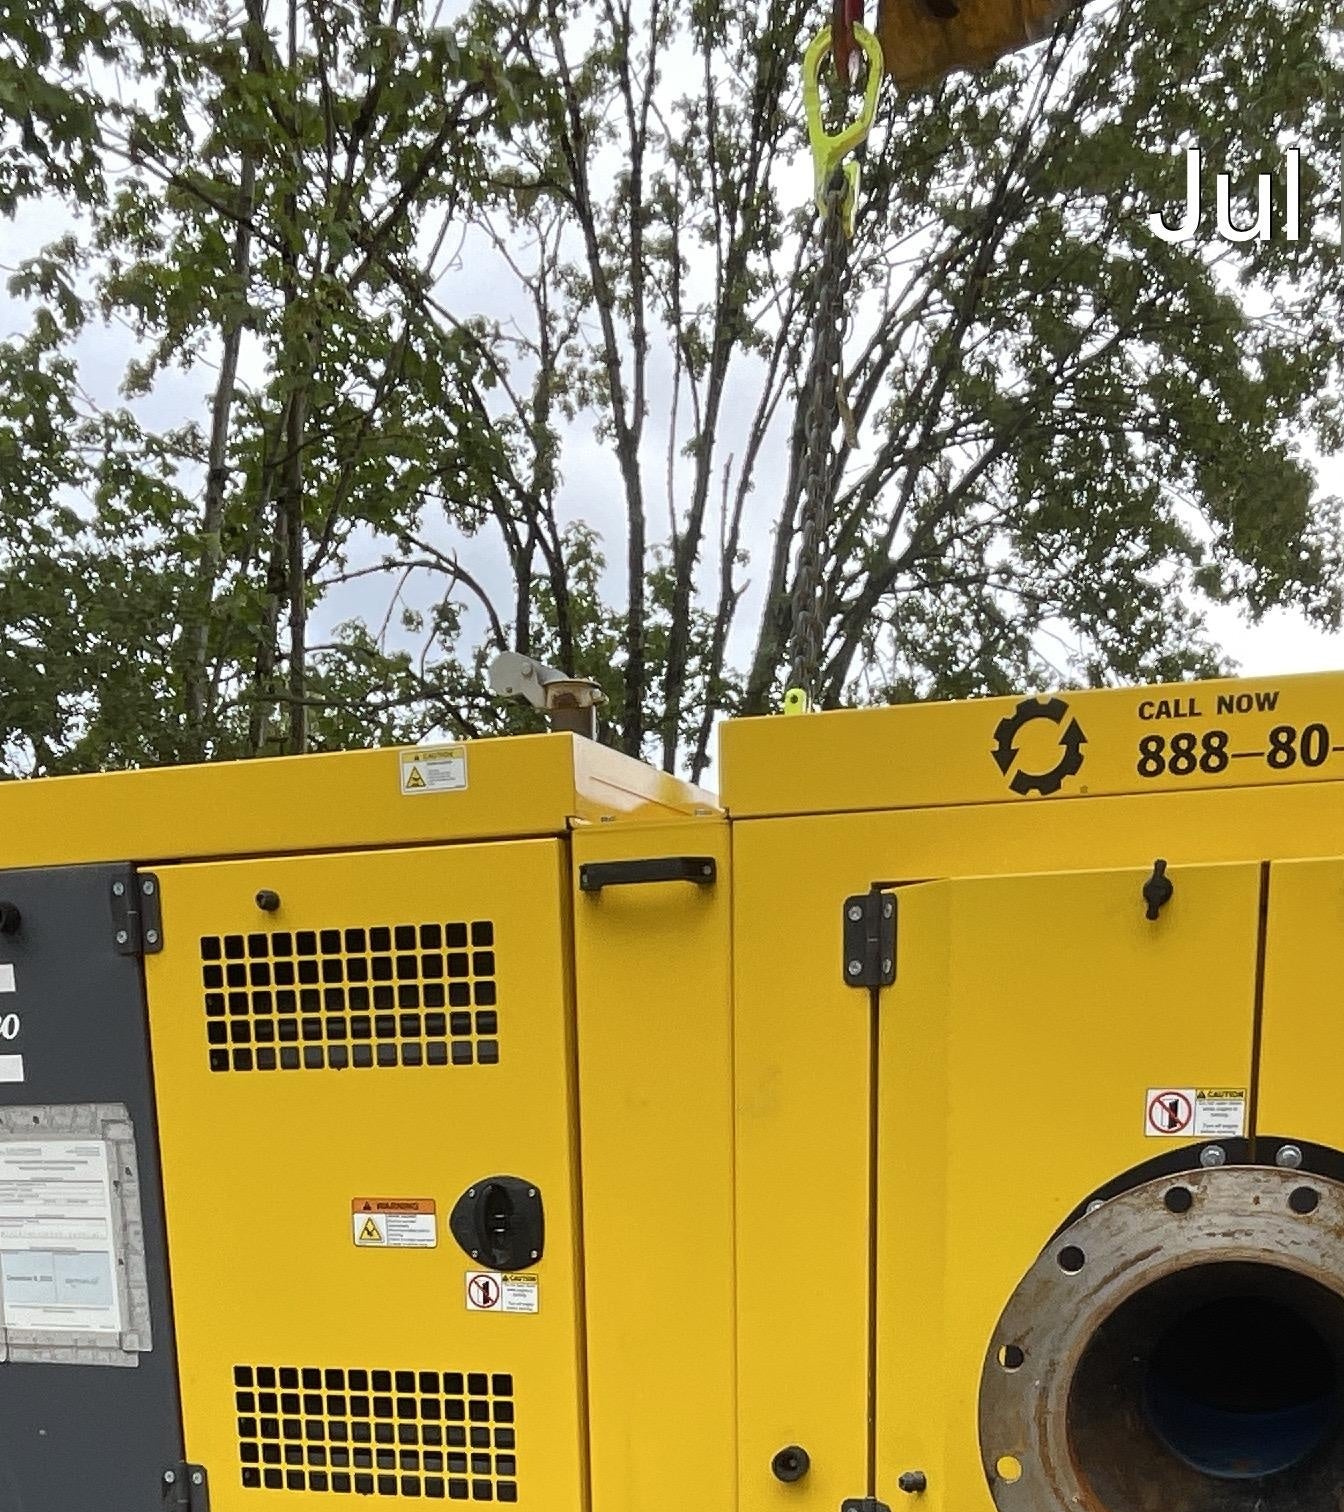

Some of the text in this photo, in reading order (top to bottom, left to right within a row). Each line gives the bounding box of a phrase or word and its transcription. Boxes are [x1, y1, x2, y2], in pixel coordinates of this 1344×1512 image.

[1138, 691, 1280, 720] CALL NOW
[1207, 1090, 1244, 1098] CAUTION
